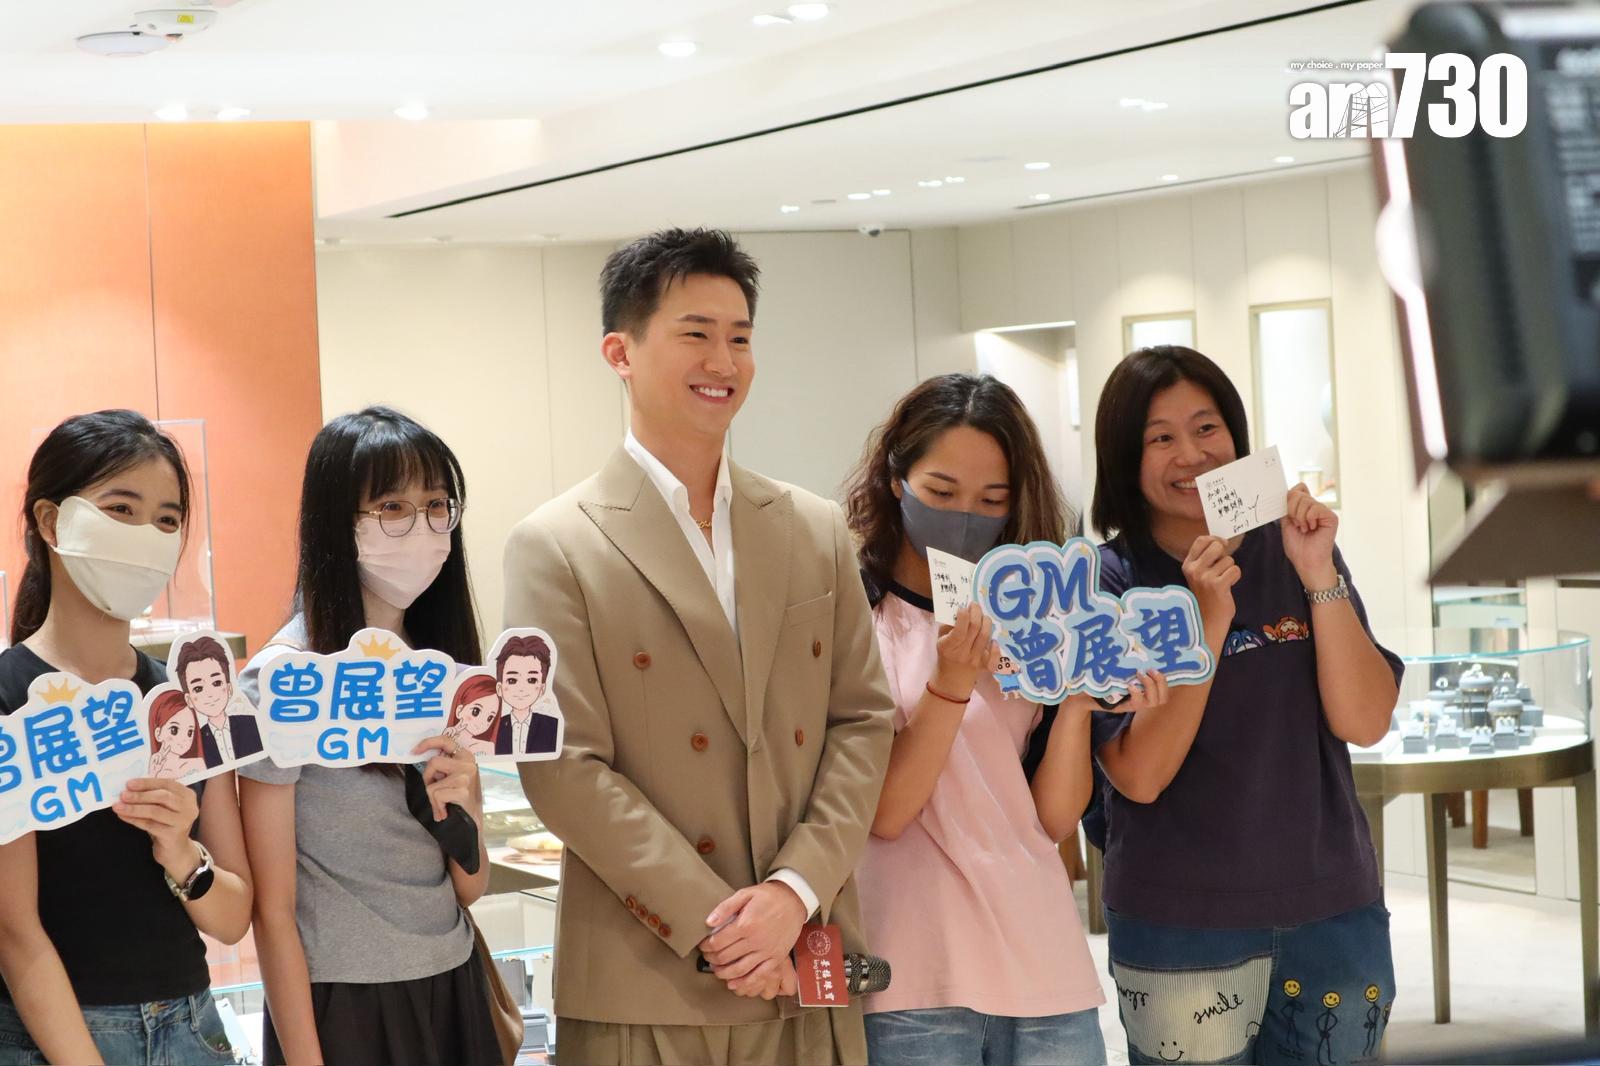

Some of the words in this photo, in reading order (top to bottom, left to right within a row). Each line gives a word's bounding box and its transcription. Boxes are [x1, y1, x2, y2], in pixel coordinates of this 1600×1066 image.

[988, 557, 1096, 622] GM
[1005, 605, 1201, 692] 曾展望
[316, 726, 389, 761] GM
[30, 771, 103, 823] GM
[1193, 992, 1244, 1025] smile
